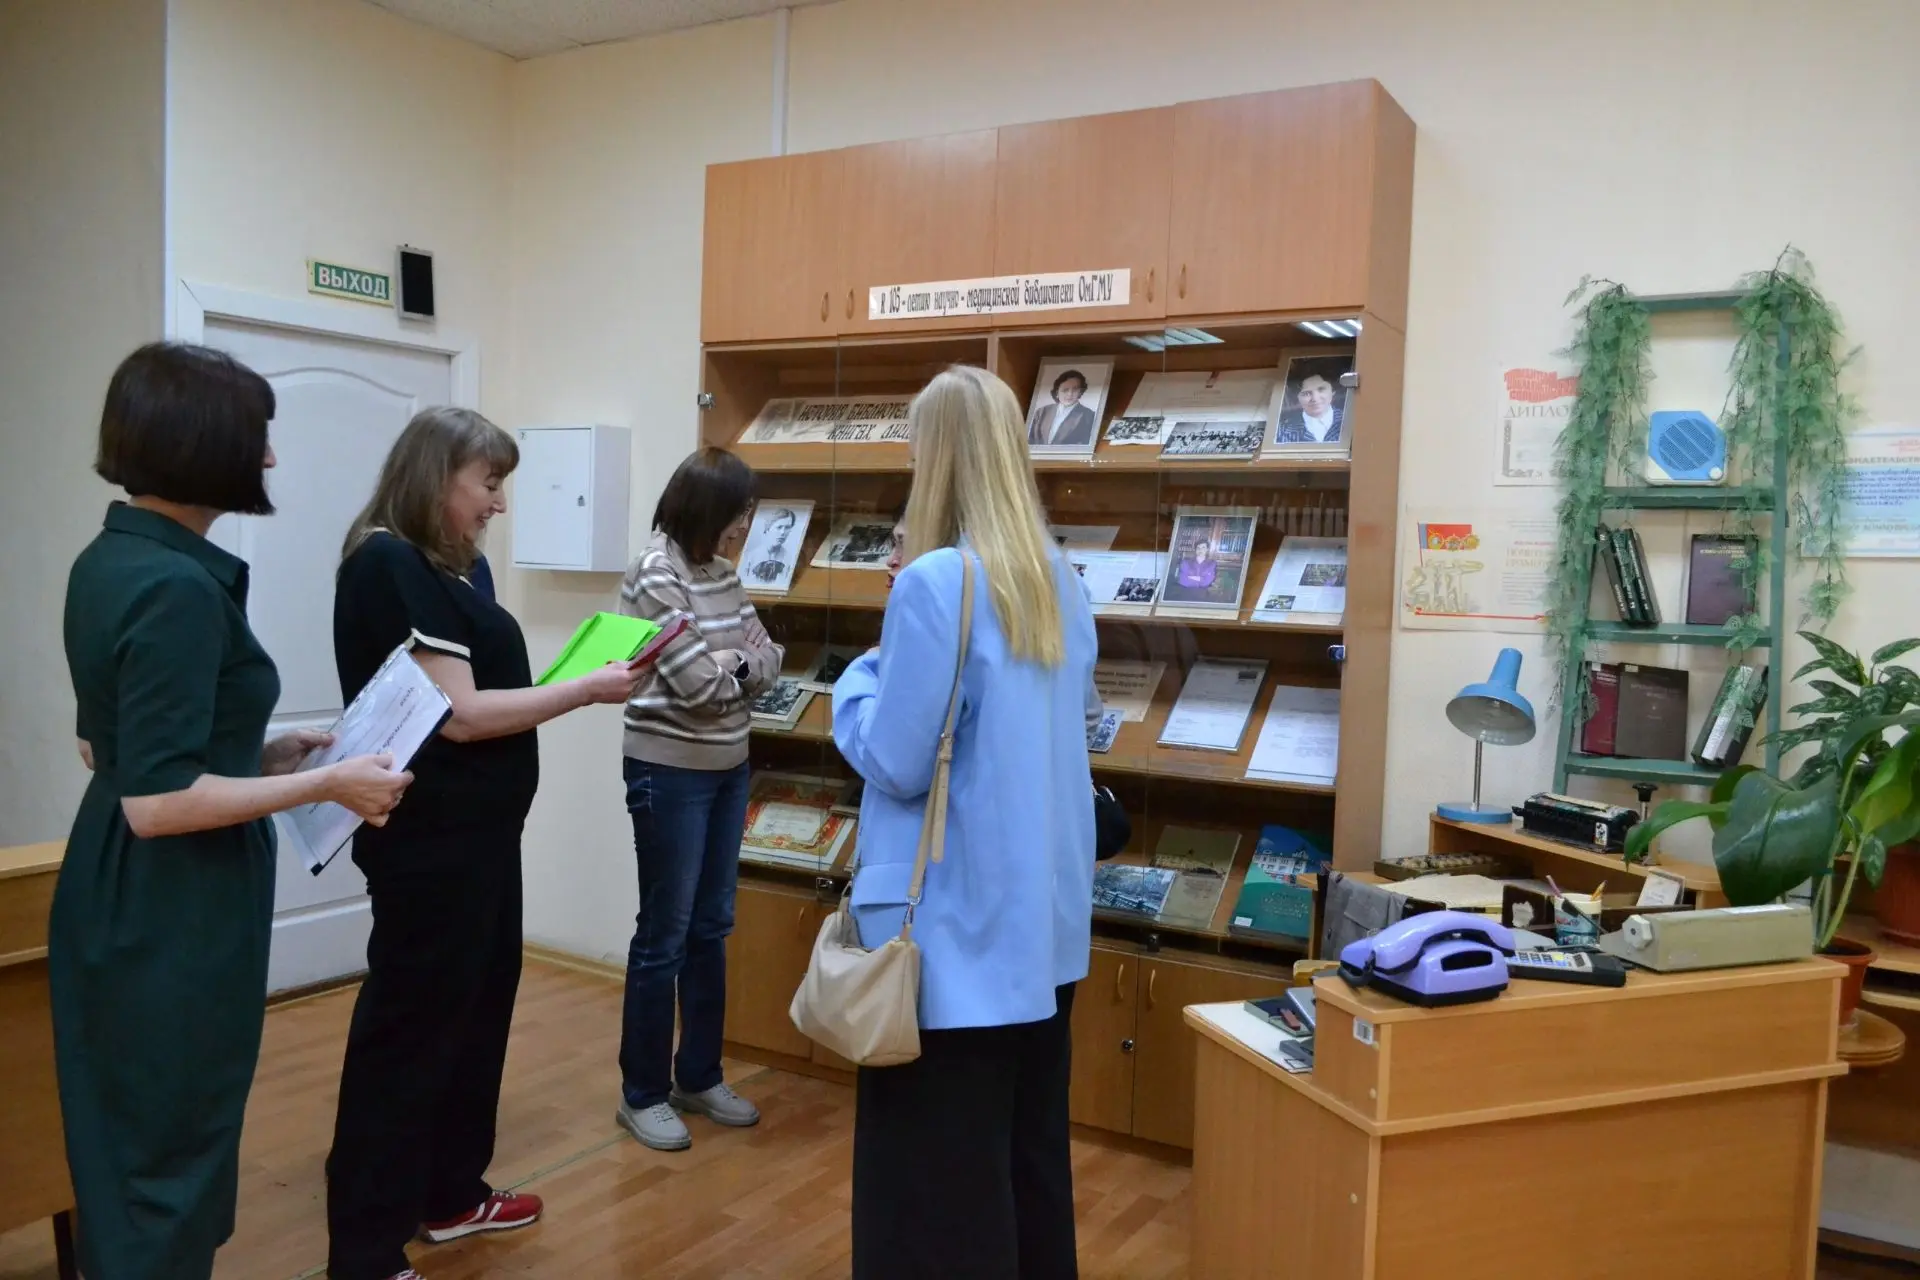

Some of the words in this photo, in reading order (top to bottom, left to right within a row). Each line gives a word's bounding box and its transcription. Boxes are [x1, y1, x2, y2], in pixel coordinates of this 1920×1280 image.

[318, 265, 387, 298] ВЫХОД
[1024, 279, 1075, 306] библиотеки
[1078, 273, 1114, 303] ОмГМУ
[1503, 404, 1576, 419] ДИПЛО
